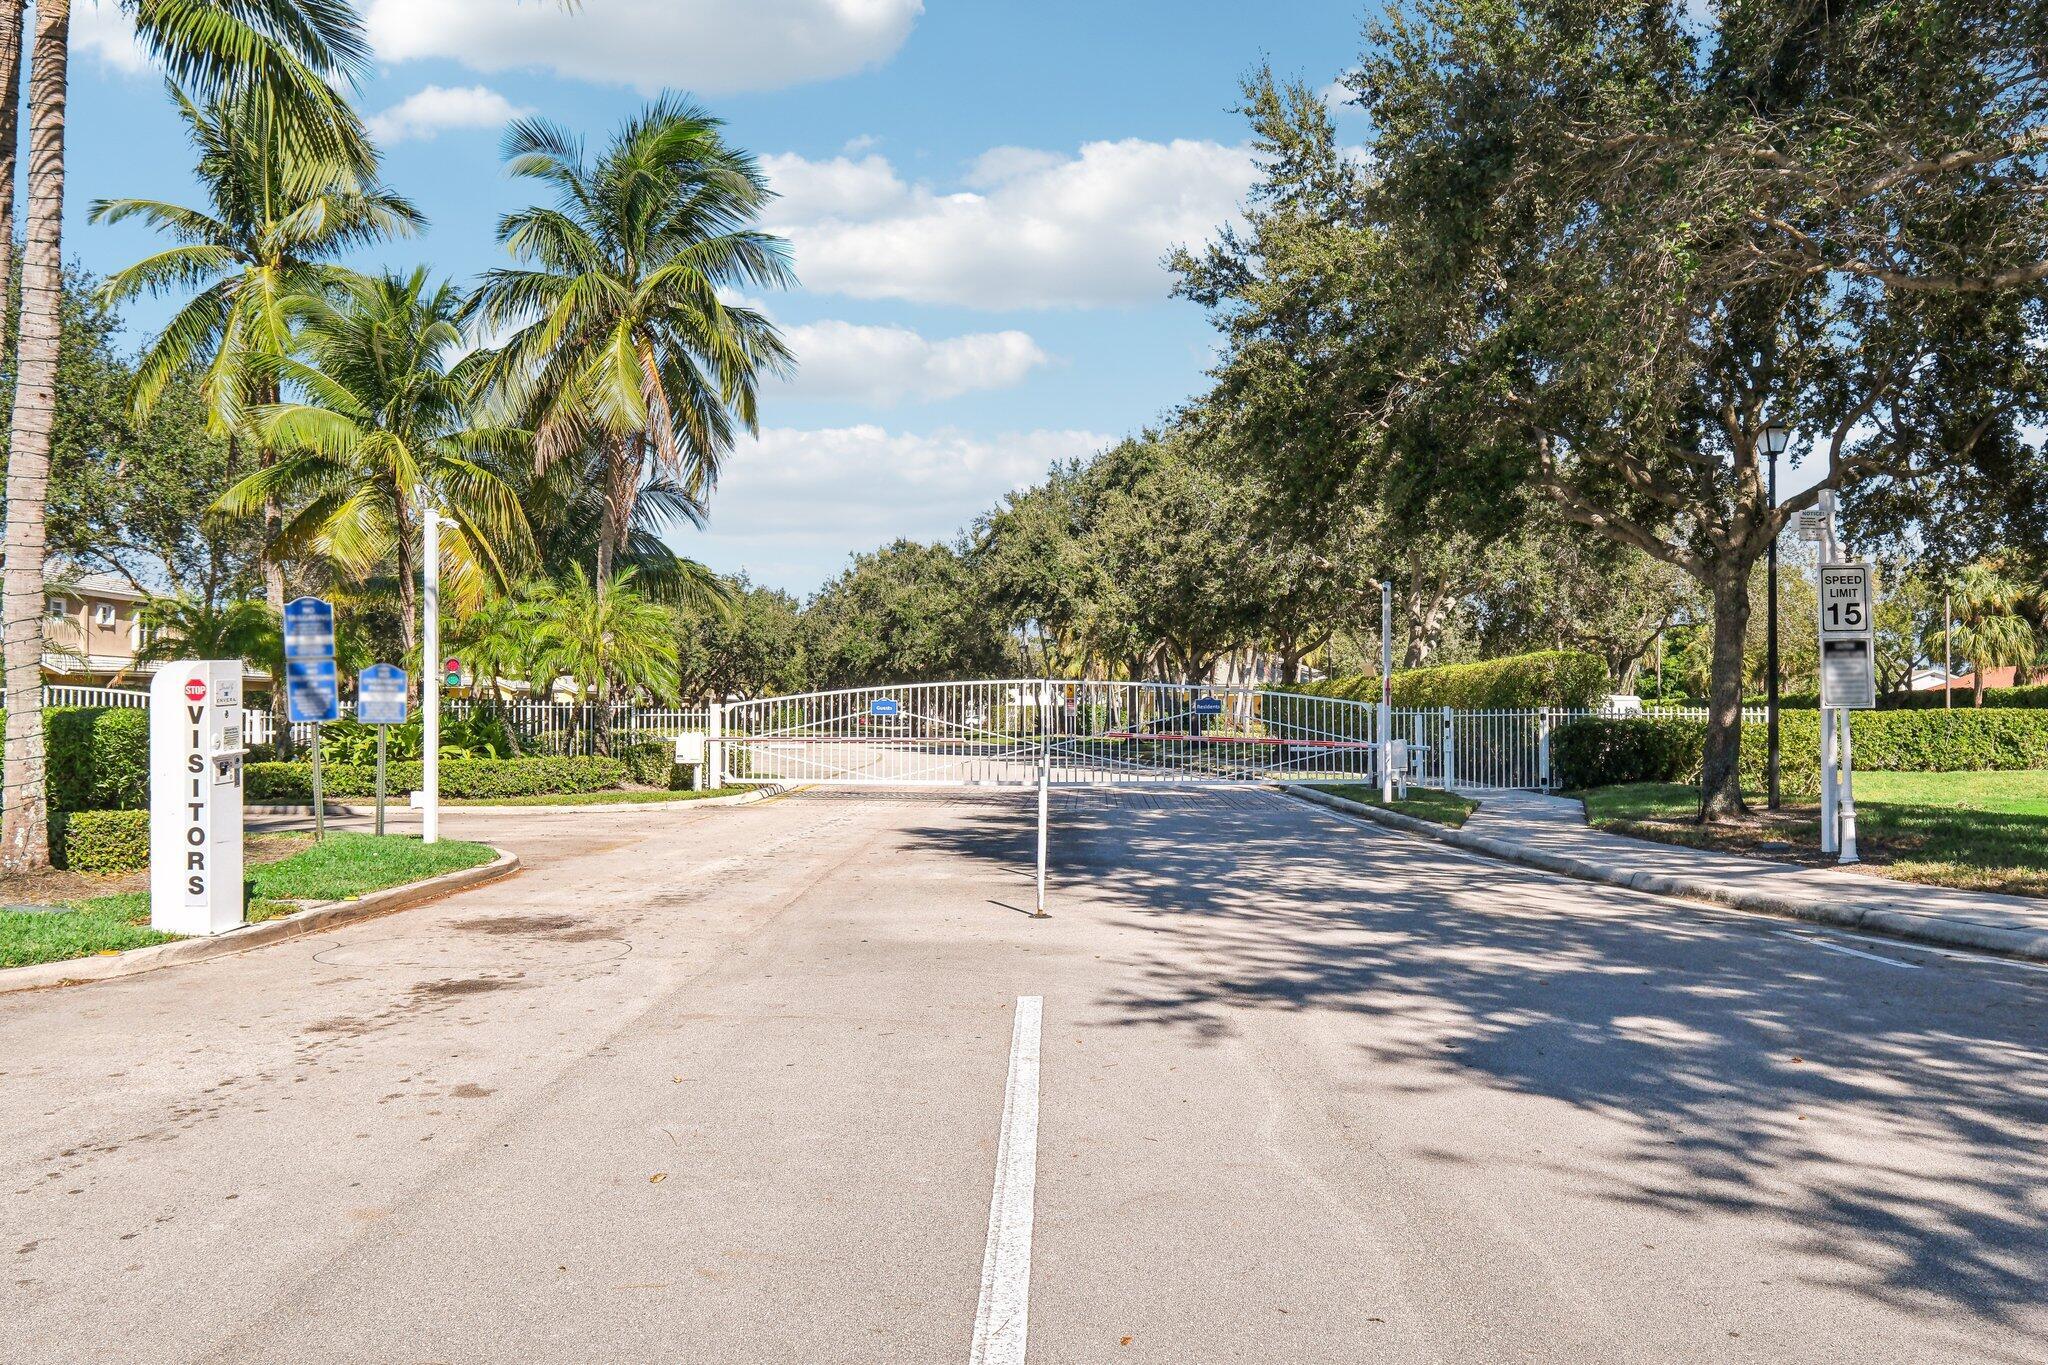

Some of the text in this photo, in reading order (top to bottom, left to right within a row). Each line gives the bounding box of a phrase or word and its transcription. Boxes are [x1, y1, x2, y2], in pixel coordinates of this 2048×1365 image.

[1825, 576, 1862, 584] SPEED
[1830, 589, 1858, 597] LIMIT
[1827, 603, 1862, 625] 15
[185, 685, 206, 695] STOP
[187, 706, 205, 895] VISITORS
